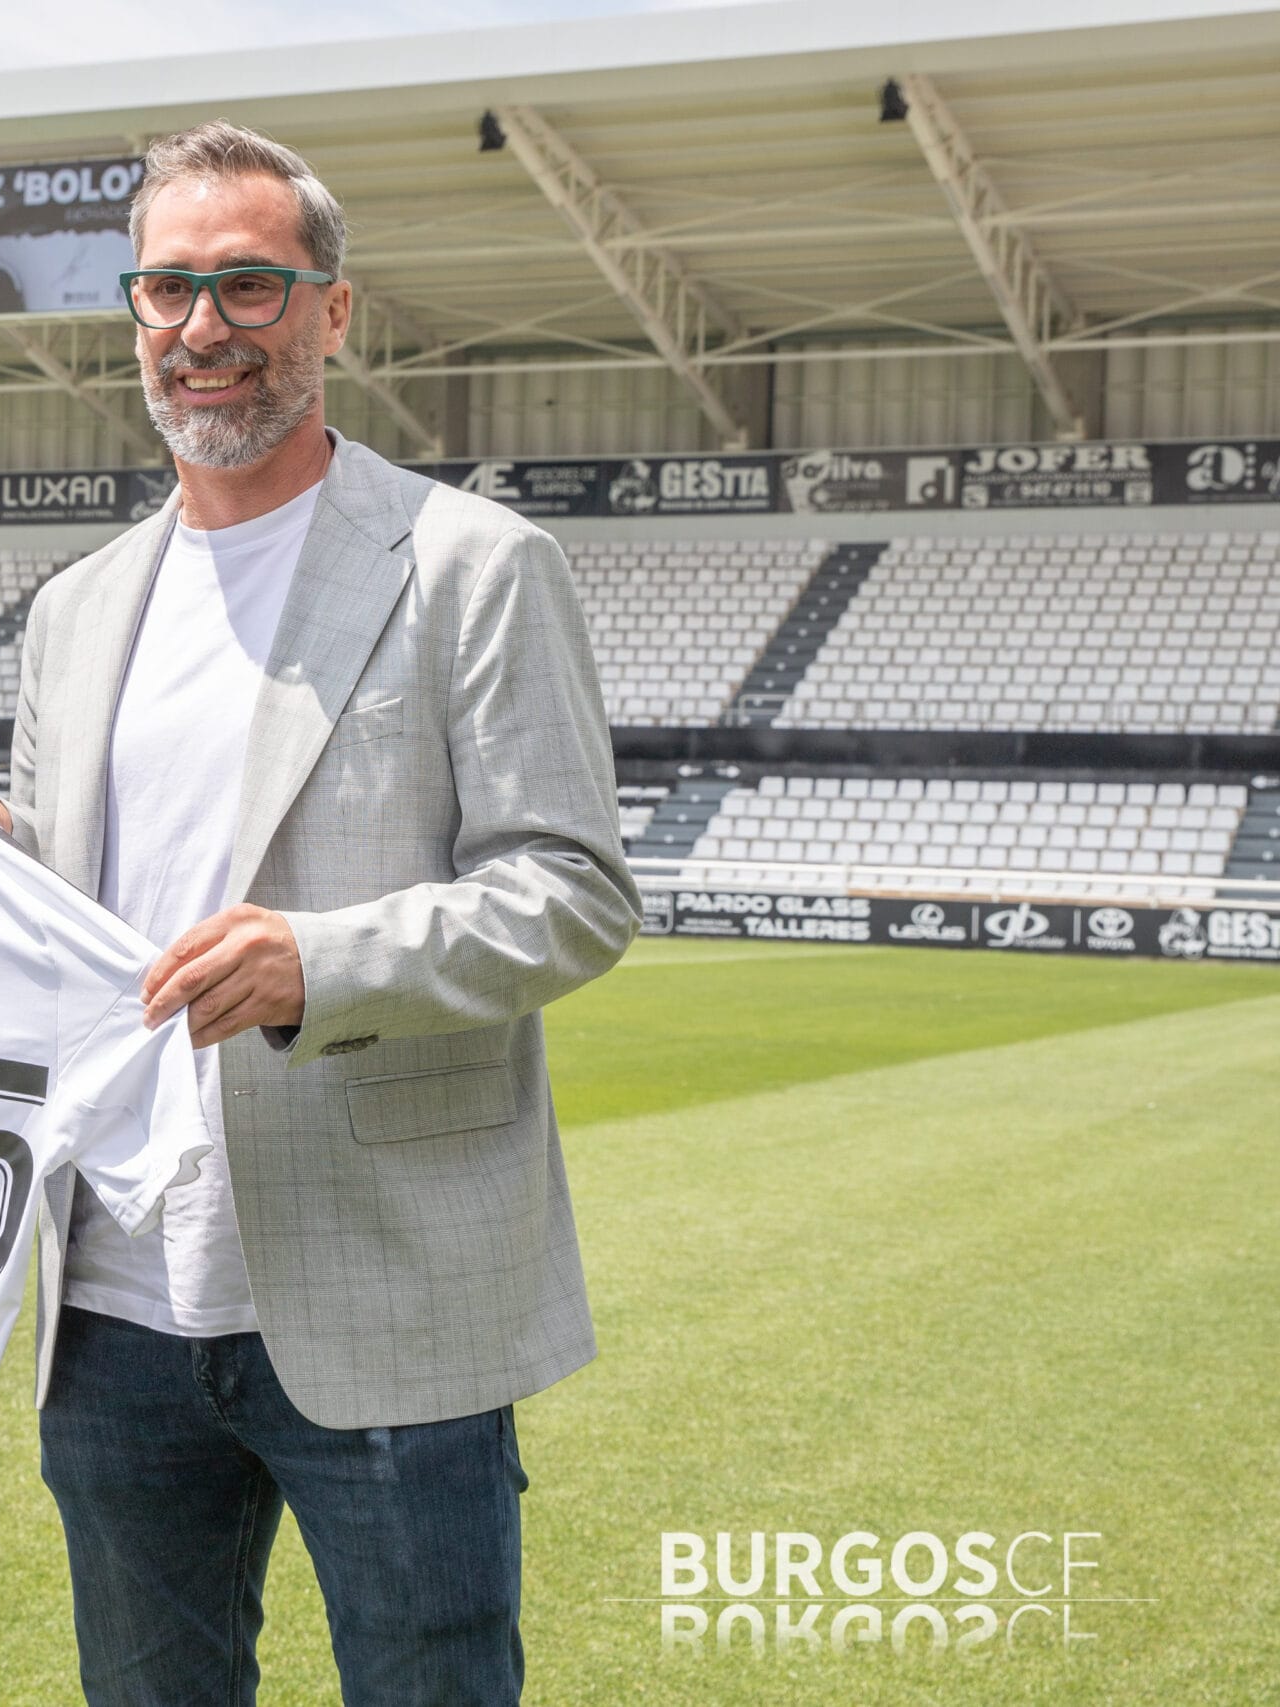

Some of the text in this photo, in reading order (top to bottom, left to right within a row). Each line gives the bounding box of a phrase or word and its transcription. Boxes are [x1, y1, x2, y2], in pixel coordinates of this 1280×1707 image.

[963, 446, 1152, 473] JOFER
[2, 475, 116, 507] LUXAN
[676, 892, 772, 914] PARDO
[776, 896, 871, 918] GLASS
[743, 916, 871, 941] TALLERES
